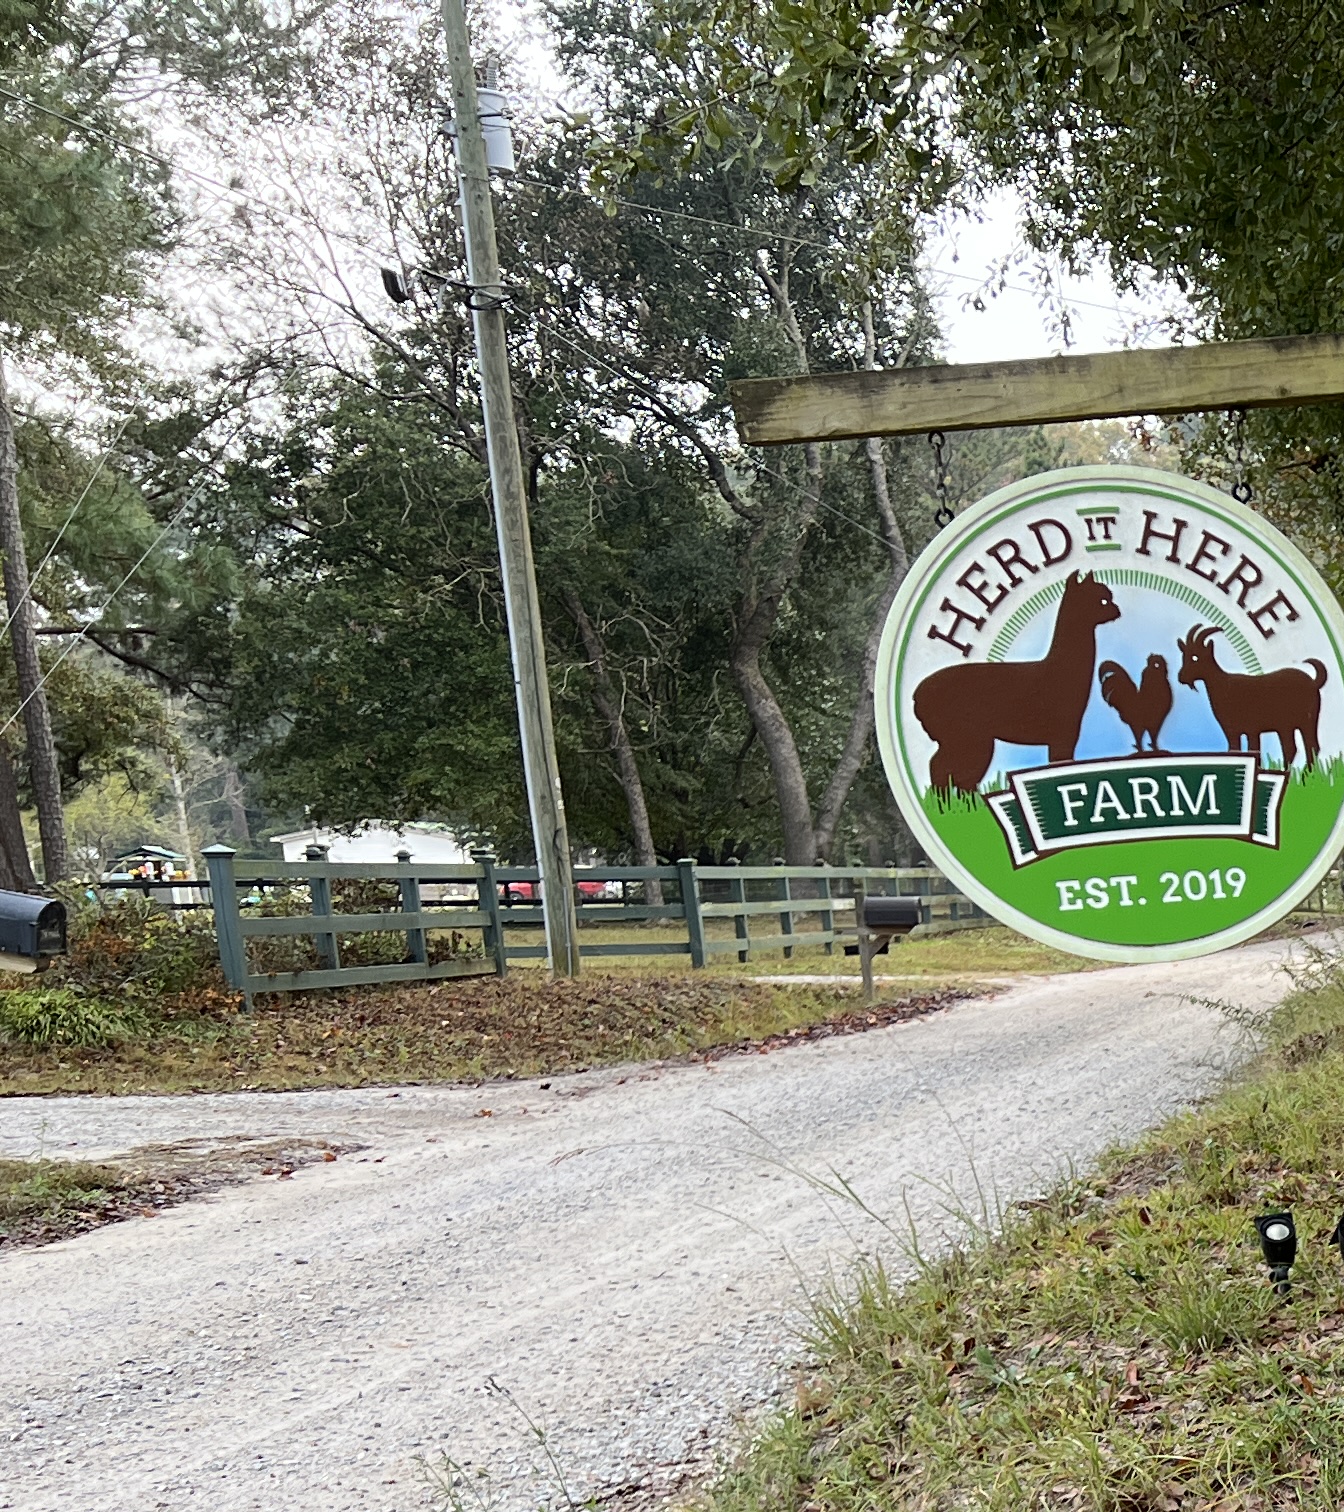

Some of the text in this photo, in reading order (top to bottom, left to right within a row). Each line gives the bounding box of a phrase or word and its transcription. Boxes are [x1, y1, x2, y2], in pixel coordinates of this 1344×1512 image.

[927, 509, 1300, 658] HERD IT HERE
[1056, 774, 1221, 826] FARM
[1055, 867, 1247, 911] EST. 2019
